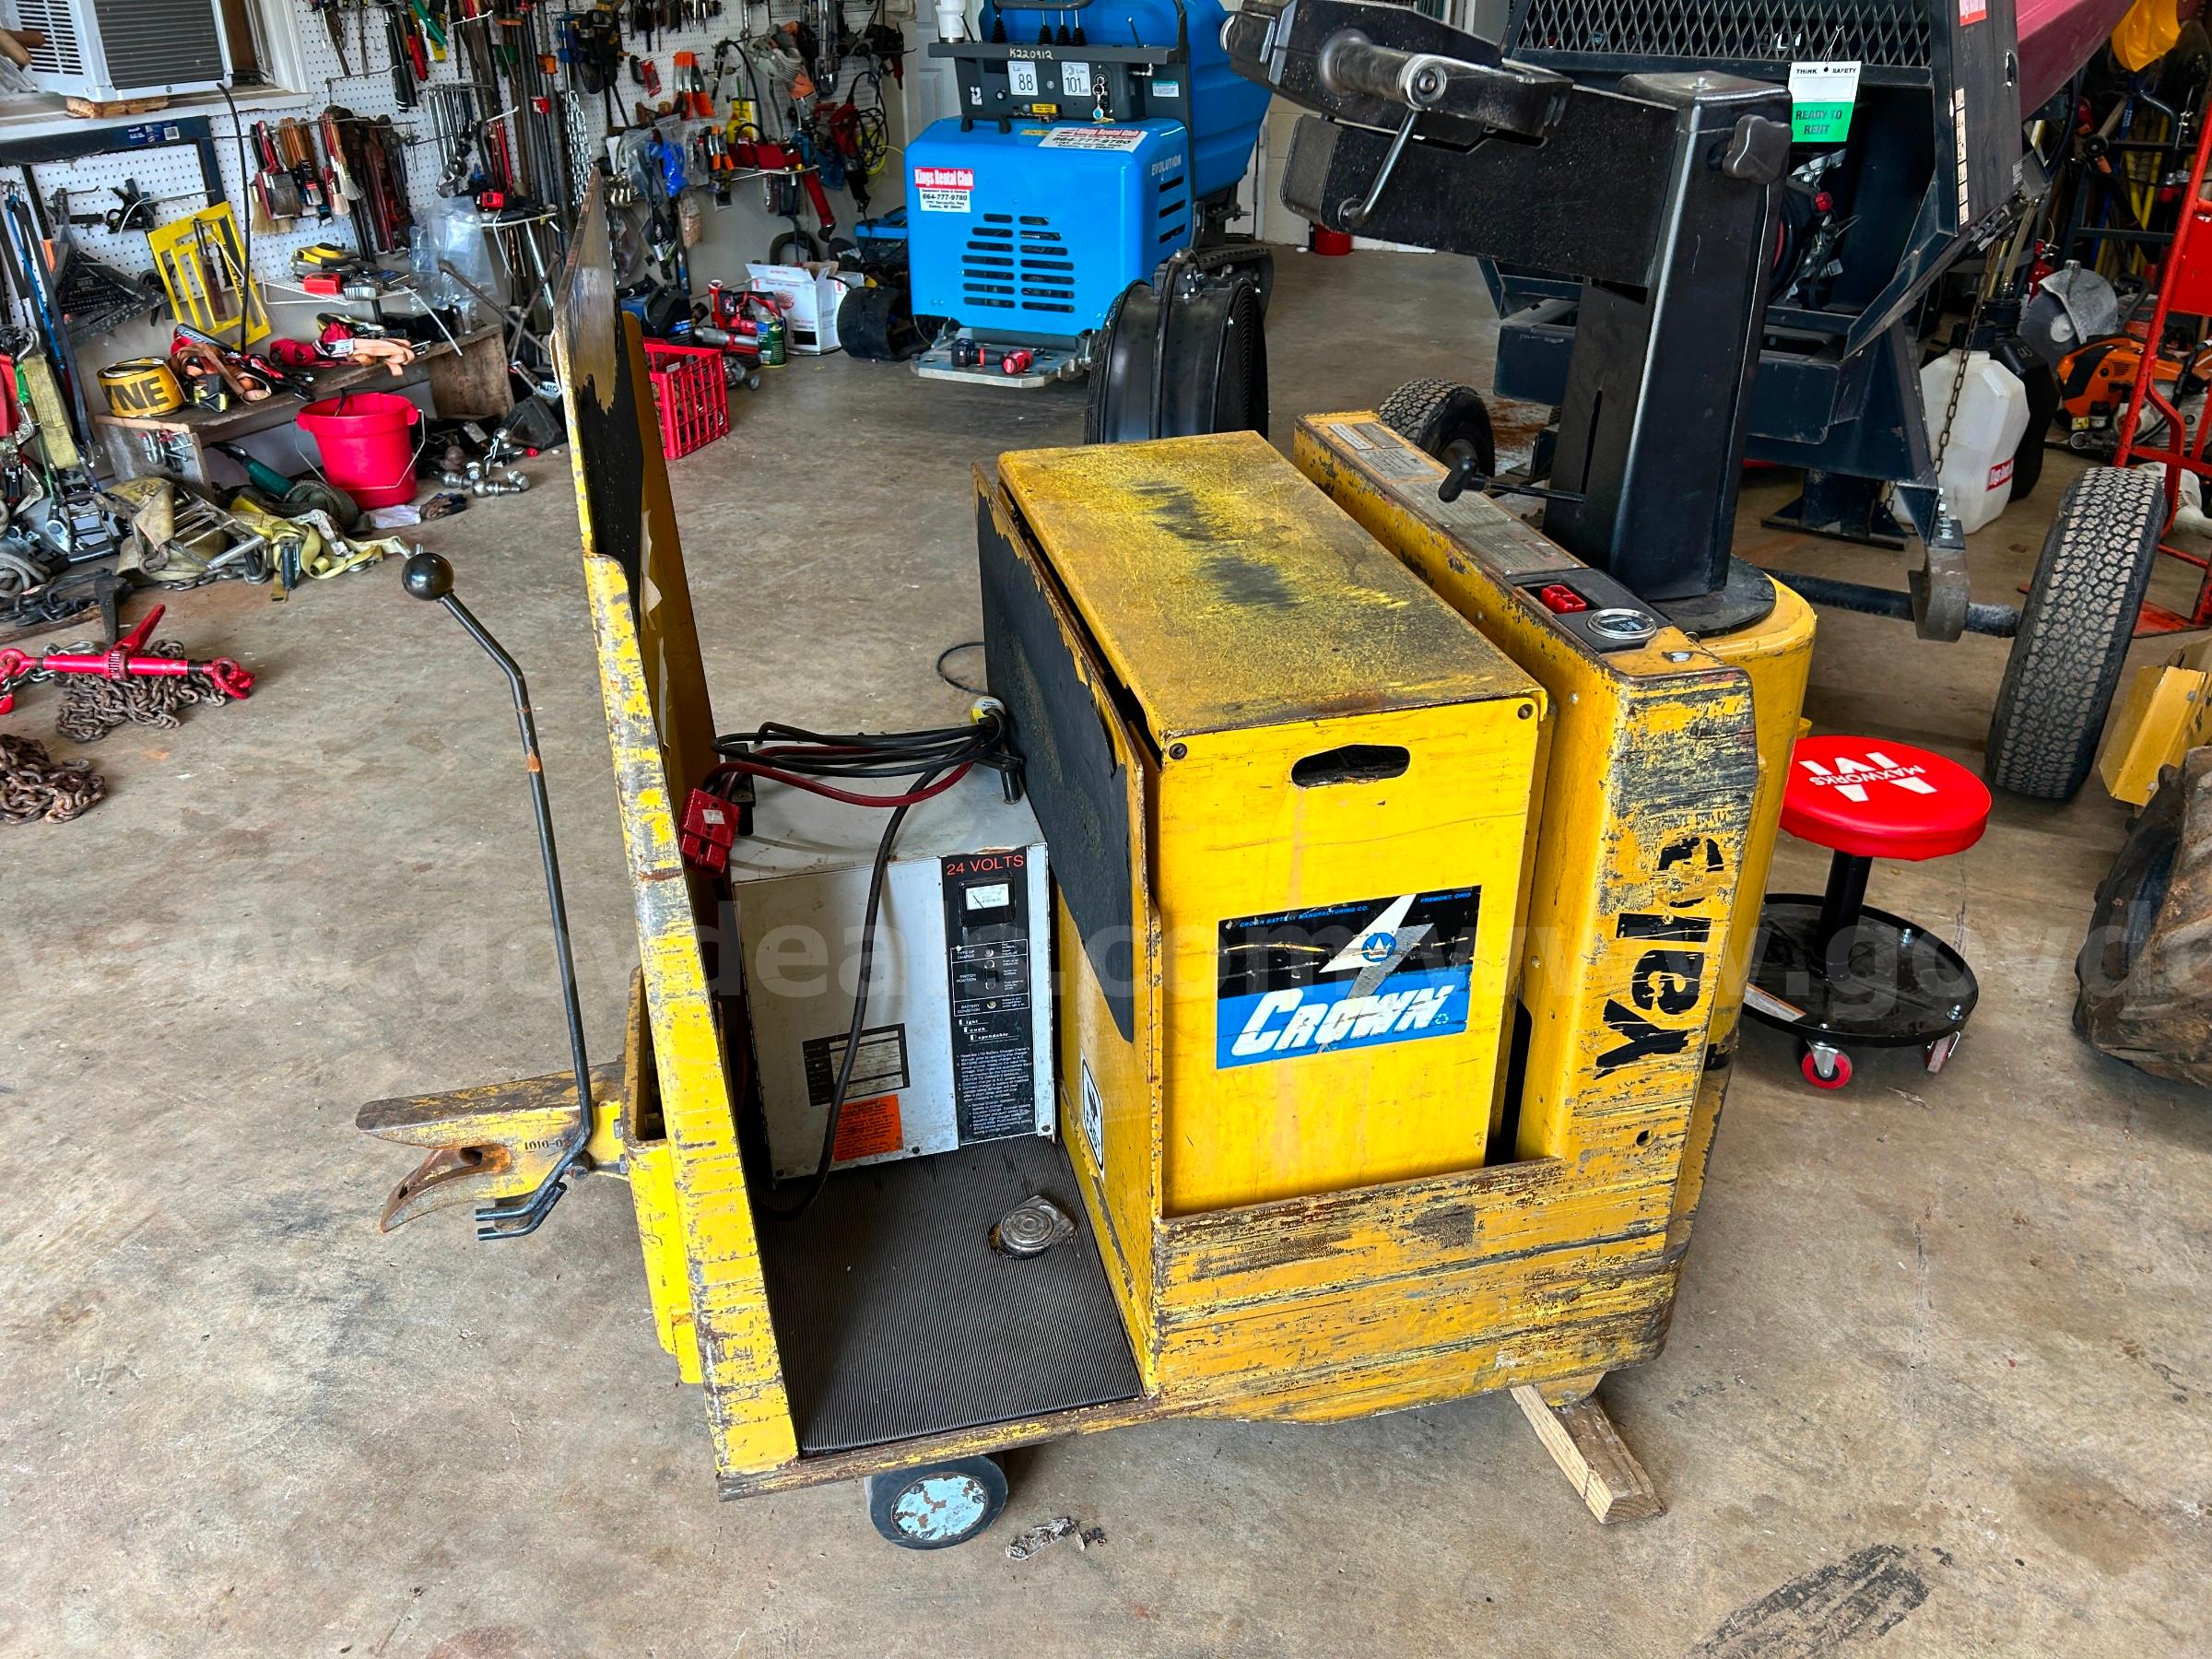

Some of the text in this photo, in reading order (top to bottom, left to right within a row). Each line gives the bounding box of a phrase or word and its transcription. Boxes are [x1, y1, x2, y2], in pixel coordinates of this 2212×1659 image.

[1018, 73, 1033, 90] 88
[1065, 76, 1082, 93] 101
[1795, 110, 1842, 120] READY TO
[1804, 124, 1830, 135] RENT
[1151, 154, 1182, 176] EVOLUTION
[1809, 764, 1925, 786] MAXWORKS
[946, 854, 1025, 876] 24 VOLTS
[1594, 836, 1724, 1080] Yale
